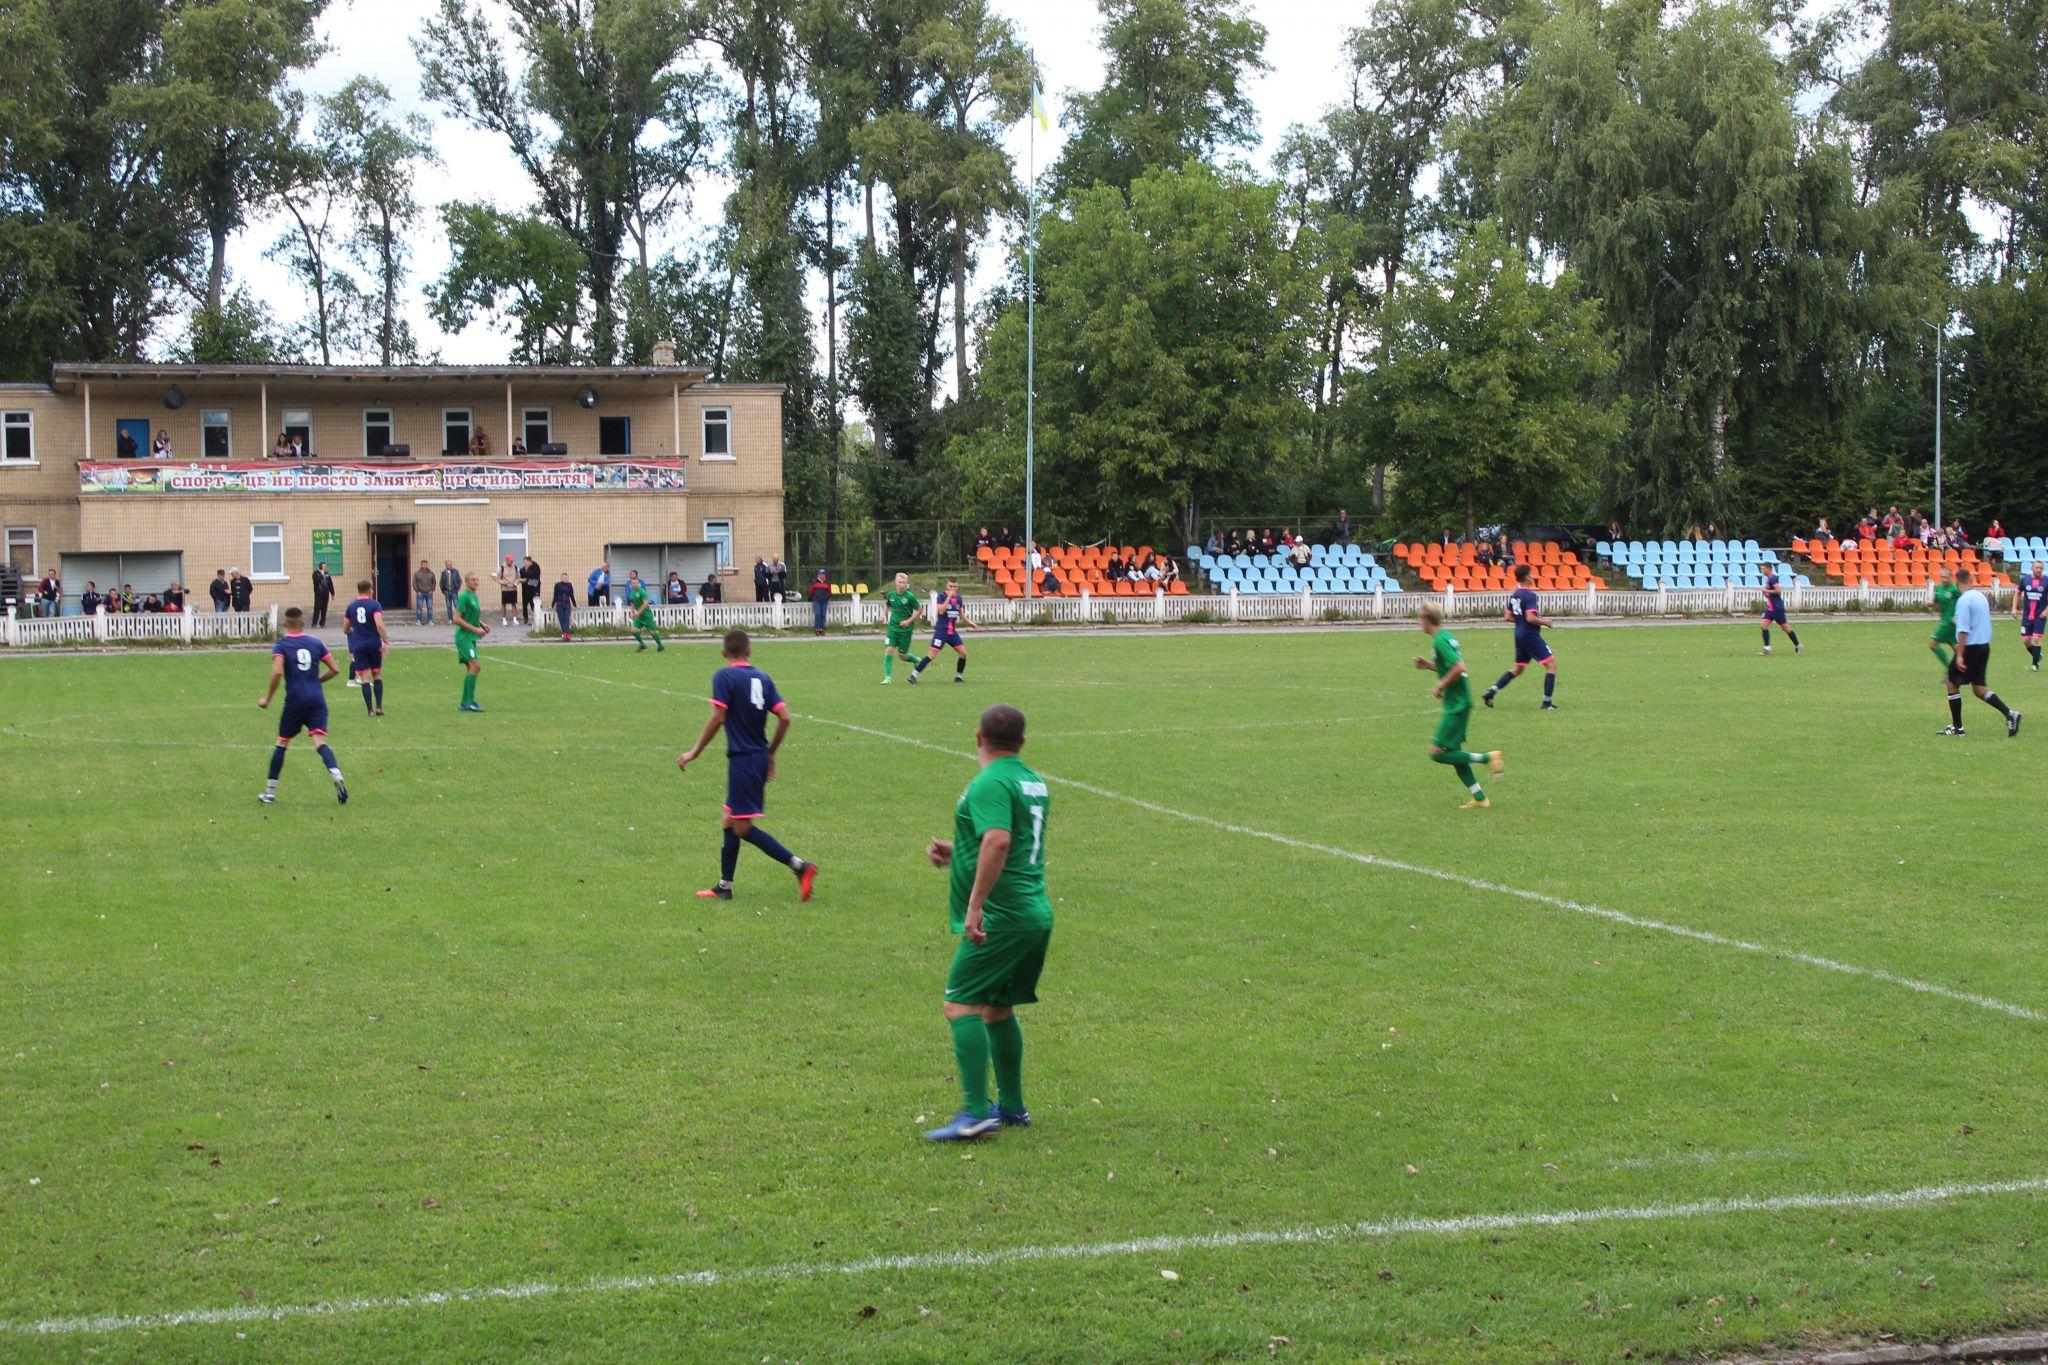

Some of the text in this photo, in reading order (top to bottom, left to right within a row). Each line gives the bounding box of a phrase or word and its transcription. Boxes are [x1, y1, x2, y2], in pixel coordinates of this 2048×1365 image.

[172, 475, 224, 487] СПОРТ
[245, 475, 266, 488] ЦЕ
[272, 475, 294, 487] НЕ
[299, 475, 358, 487] ПРОСТО
[364, 475, 440, 488] ЗАНЯТТЯ,
[444, 475, 465, 488] ЦЕ
[470, 474, 521, 486] СТИЛЬ
[525, 472, 588, 485] ЖИТТЯ!
[356, 606, 367, 624] 8
[296, 648, 312, 671] 9
[750, 677, 766, 710] 4
